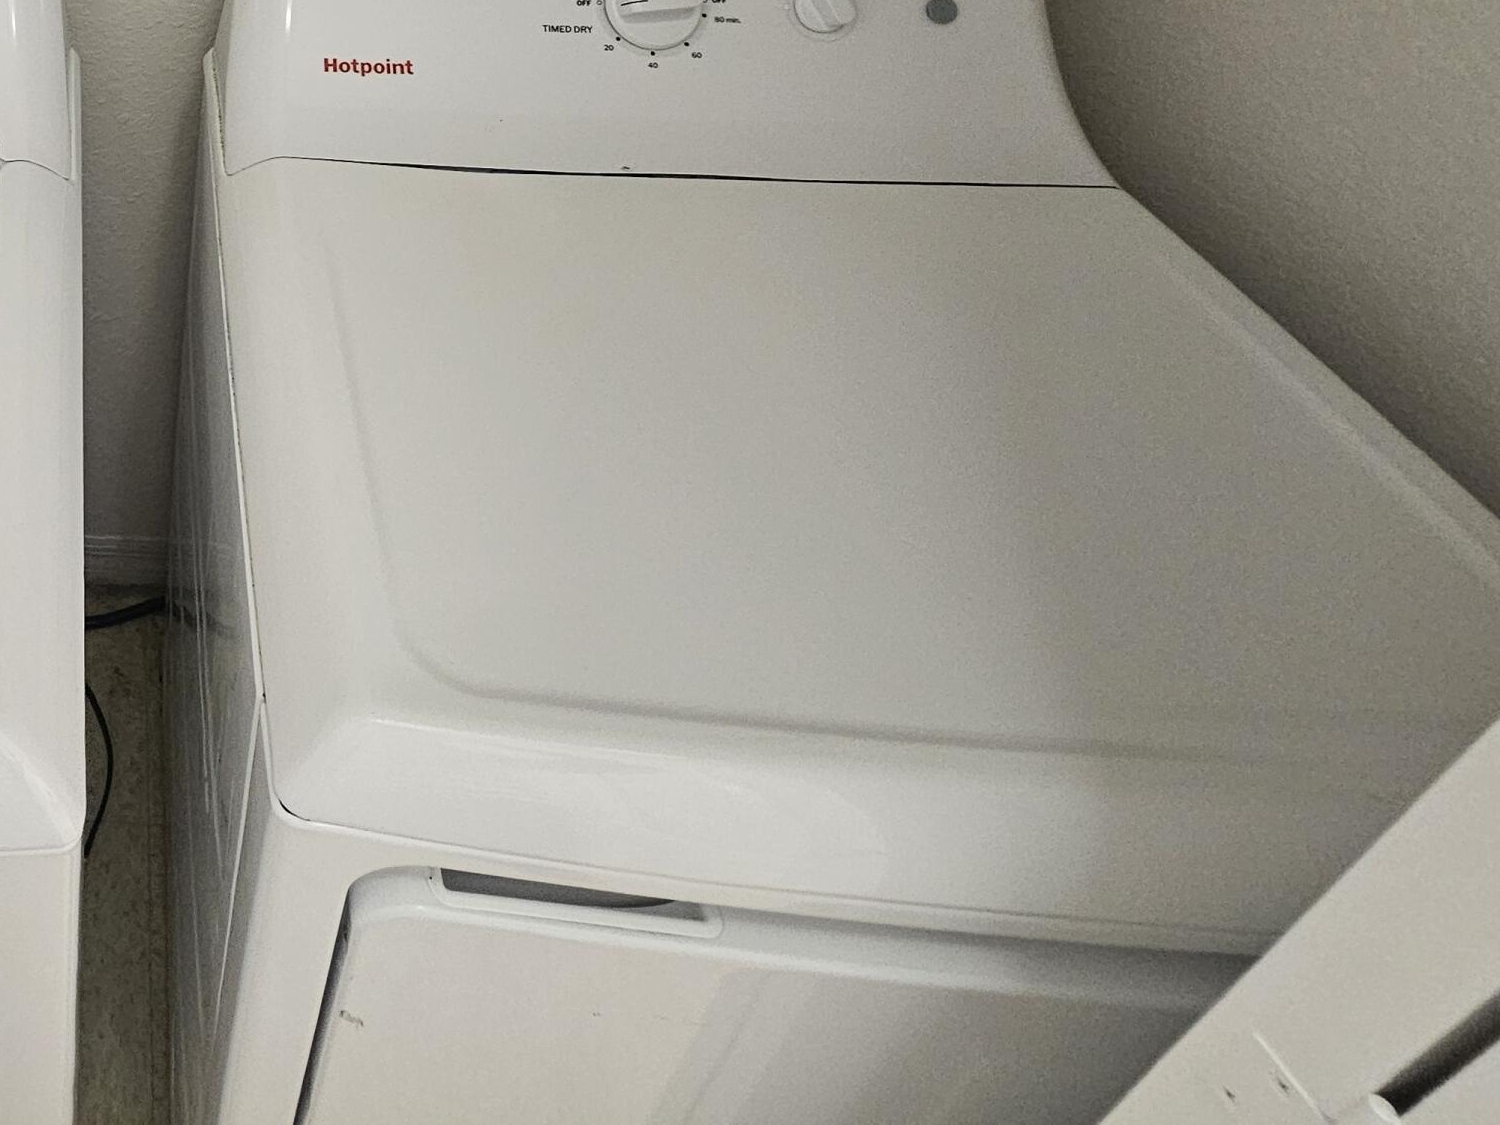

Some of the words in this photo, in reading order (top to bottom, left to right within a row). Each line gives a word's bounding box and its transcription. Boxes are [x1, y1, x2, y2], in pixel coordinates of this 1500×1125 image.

[543, 25, 572, 33] TIMED
[574, 25, 593, 34] DRY
[691, 51, 703, 59] 60
[323, 57, 415, 77] Hotpoint
